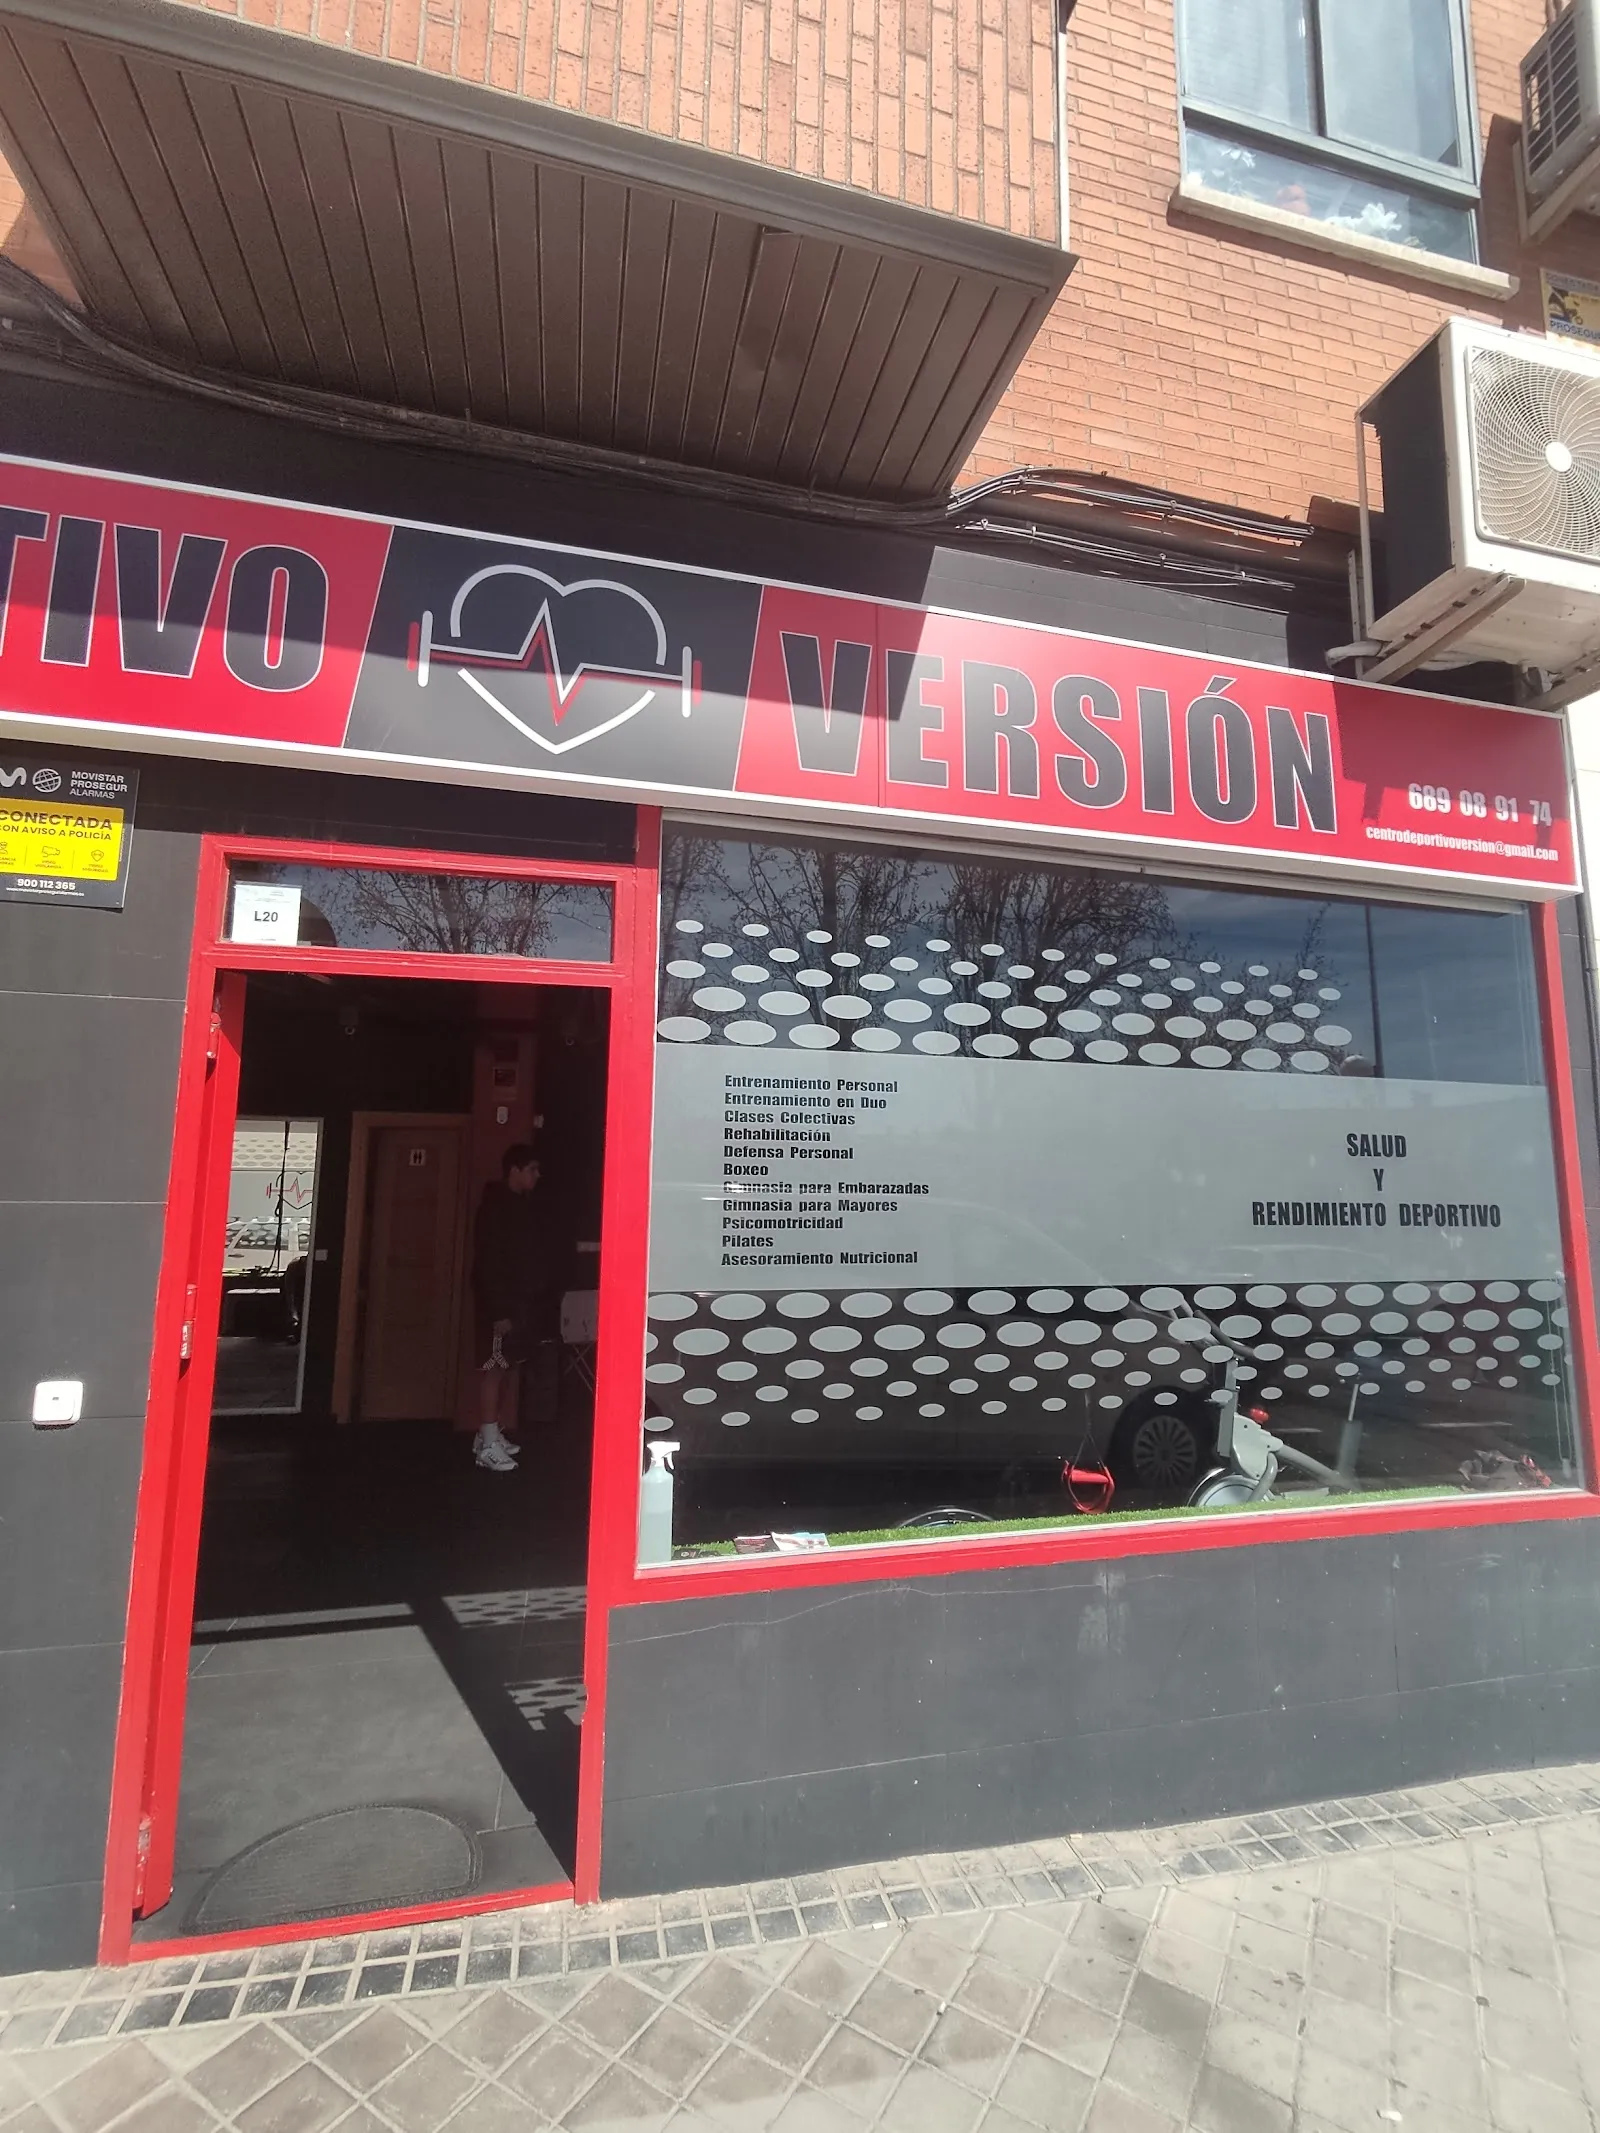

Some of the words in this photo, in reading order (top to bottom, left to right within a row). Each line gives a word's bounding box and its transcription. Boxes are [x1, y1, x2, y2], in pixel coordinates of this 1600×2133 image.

[0, 504, 329, 692] IVO
[780, 630, 1338, 834] VERSIÓN
[71, 770, 125, 784] MOVISTAR
[70, 780, 128, 792] PROSEGUR
[69, 788, 115, 799] ALARMAS
[1408, 783, 1452, 814] 689
[1459, 790, 1488, 818] 08
[1495, 795, 1519, 823] 91
[1529, 800, 1553, 827] 74
[0, 824, 20, 833] ON
[21, 826, 56, 836] AVISO
[1366, 826, 1559, 862] centrodeportivoversion@gmail.com
[17, 878, 38, 888] 900
[39, 879, 54, 889] 112
[55, 880, 76, 890] 365
[254, 911, 279, 922] L20
[725, 1075, 831, 1091] Entrenamiento
[836, 1079, 898, 1093] Personal
[724, 1093, 831, 1108] Entrenamiento
[837, 1097, 855, 1109] en
[860, 1097, 887, 1109] Duo
[724, 1111, 774, 1123] Clases
[780, 1112, 856, 1126] Colectivas
[724, 1128, 831, 1142] Rehabilitación
[723, 1146, 784, 1158] Defensa
[790, 1147, 854, 1159] Personal
[1346, 1133, 1407, 1158] SALUD
[723, 1164, 769, 1176] Boxeo
[1373, 1168, 1384, 1192] Y
[799, 1183, 832, 1195] para
[838, 1182, 930, 1195] Embarazadas
[722, 1200, 793, 1212] Gimnasia
[799, 1200, 832, 1213] para
[838, 1200, 898, 1213] Mayores
[1252, 1201, 1387, 1226] RENDIMIENTO
[1399, 1203, 1502, 1228] DEPORTIVO
[722, 1217, 844, 1230] Psicomotricidad
[721, 1235, 774, 1248] Pilates
[721, 1253, 834, 1267] Asesoramiento
[840, 1251, 918, 1264] Nutricional
